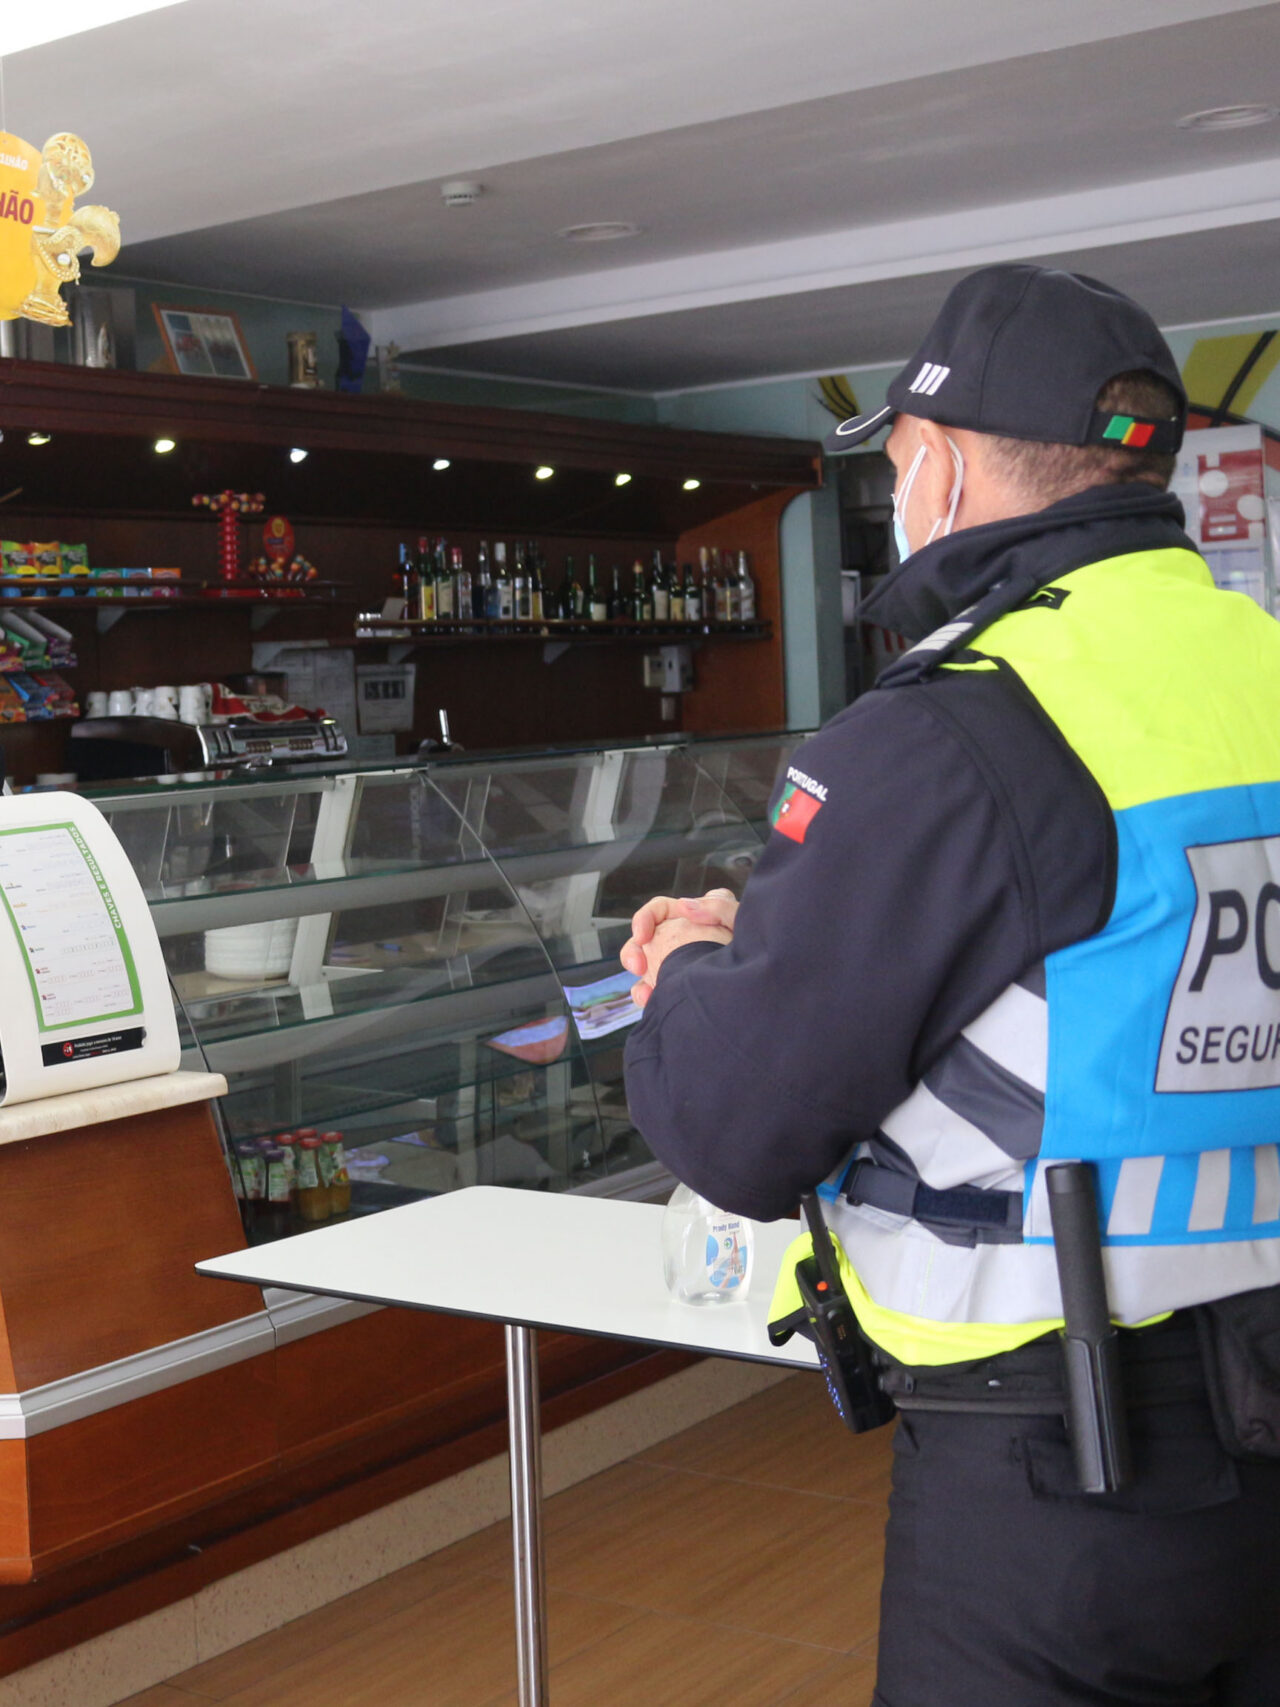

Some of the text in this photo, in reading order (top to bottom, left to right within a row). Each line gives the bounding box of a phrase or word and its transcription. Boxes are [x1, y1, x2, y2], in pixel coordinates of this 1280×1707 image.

[786, 766, 828, 802] PORTUGAL
[69, 826, 103, 882] RESULTADOS
[102, 891, 122, 929] CHAVES
